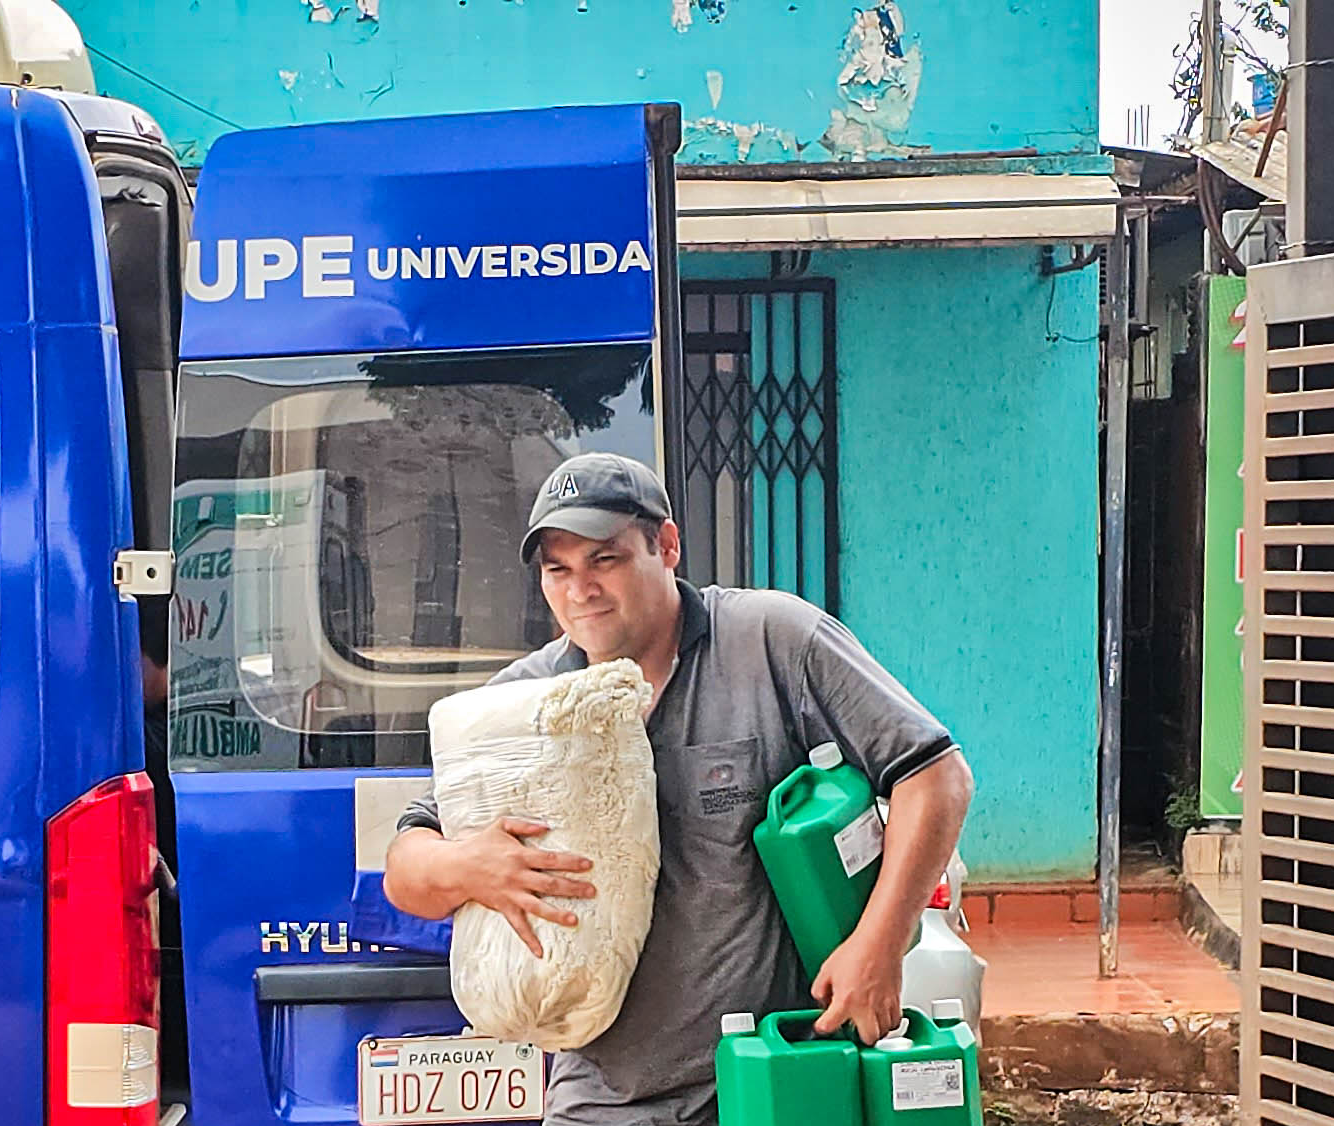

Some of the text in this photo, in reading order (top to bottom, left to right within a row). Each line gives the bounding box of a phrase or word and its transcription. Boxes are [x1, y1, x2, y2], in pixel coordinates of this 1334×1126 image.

[185, 235, 652, 301] UPE UNIVERSIDA
[408, 1049, 496, 1067] PARAGUAY
[379, 1069, 527, 1116] HDZ 076
